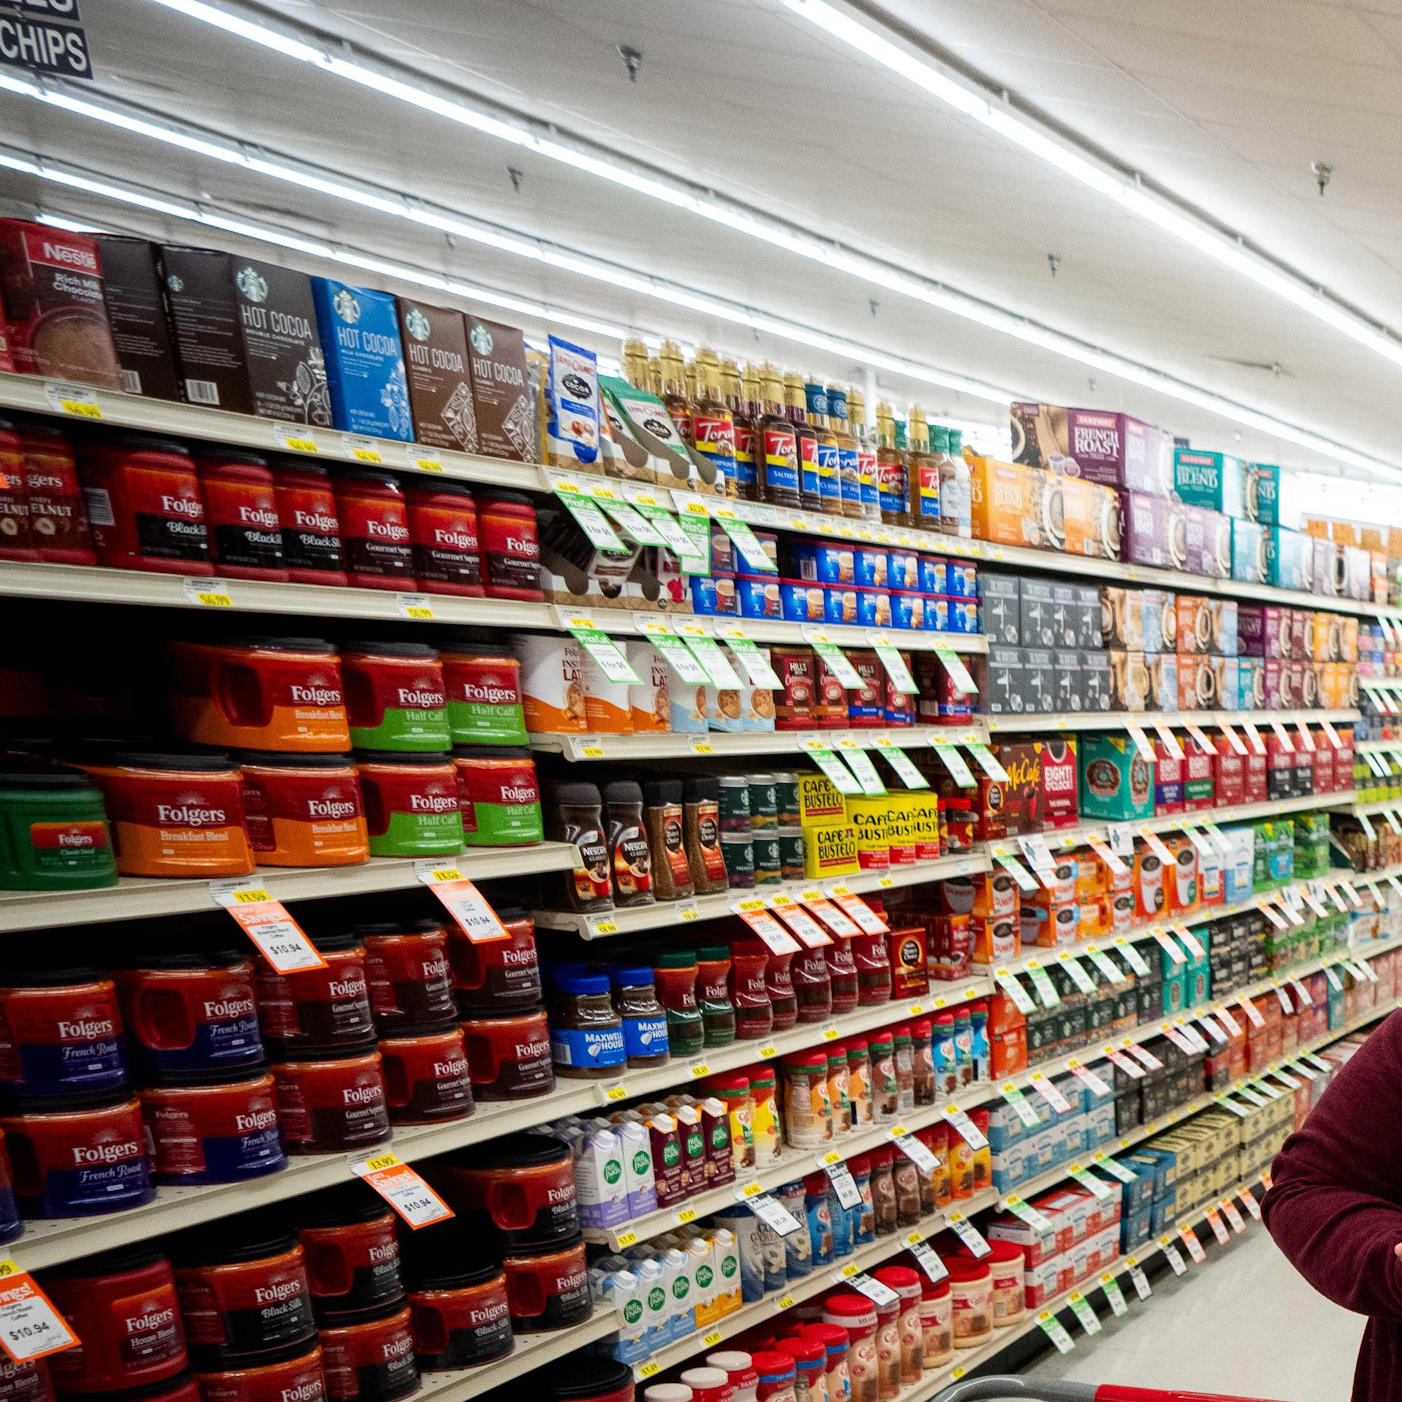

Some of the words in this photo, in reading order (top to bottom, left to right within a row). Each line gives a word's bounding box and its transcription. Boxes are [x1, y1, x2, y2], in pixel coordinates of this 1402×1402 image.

[0, 19, 87, 71] CHIPS
[240, 305, 267, 329] HOT
[271, 311, 313, 341] COCOA
[337, 326, 360, 349] HOT
[362, 332, 398, 357] COCOA
[408, 344, 429, 364] HOT
[430, 349, 465, 375] COCOA
[473, 358, 493, 378] HOT
[494, 362, 525, 388] COCOA
[1074, 427, 1120, 444] FRENCH
[1076, 438, 1120, 459] ROAST
[295, 509, 340, 532] Folgers
[434, 528, 479, 549] Folgers
[290, 685, 342, 705] Folgers
[398, 687, 445, 708] Folgers
[463, 682, 516, 703] Folgers
[406, 710, 427, 722] Half
[471, 704, 495, 717] Half
[496, 705, 516, 718] Caff
[411, 794, 458, 813] Folgers
[500, 785, 536, 803] Folgers
[157, 804, 226, 826] Folgers
[308, 800, 356, 819] Folgers
[418, 816, 440, 827] Half
[58, 833, 93, 845] Folgers
[160, 831, 202, 842] Breakfast
[818, 842, 856, 859] BUSTELO
[270, 943, 302, 955] $10.94
[502, 949, 538, 966] Folgers
[328, 978, 367, 999] Folgers
[203, 998, 255, 1020] Folgers
[58, 1019, 113, 1042] Folgers
[209, 1023, 238, 1039] French
[585, 1030, 623, 1044] MAXWELL
[638, 1021, 668, 1033] MAXWE
[62, 1045, 96, 1061] French
[514, 1040, 551, 1061] Folgers
[601, 1040, 624, 1050] HOUSE
[433, 1058, 469, 1079] Folgers
[343, 1083, 383, 1104] Folgers
[235, 1109, 277, 1132] Folgers
[73, 1141, 139, 1164] Folgers
[79, 1168, 115, 1185] French
[404, 1198, 432, 1212] $10.94
[557, 1270, 588, 1290] Folgers
[255, 1278, 301, 1304] Folgers
[125, 1308, 174, 1333] Folgers
[261, 1305, 287, 1320] Black
[470, 1302, 508, 1324] Folgers
[8, 1321, 50, 1341] $10.94
[131, 1334, 157, 1348] House
[157, 1326, 177, 1341] Blend
[383, 1335, 414, 1358] Folgers
